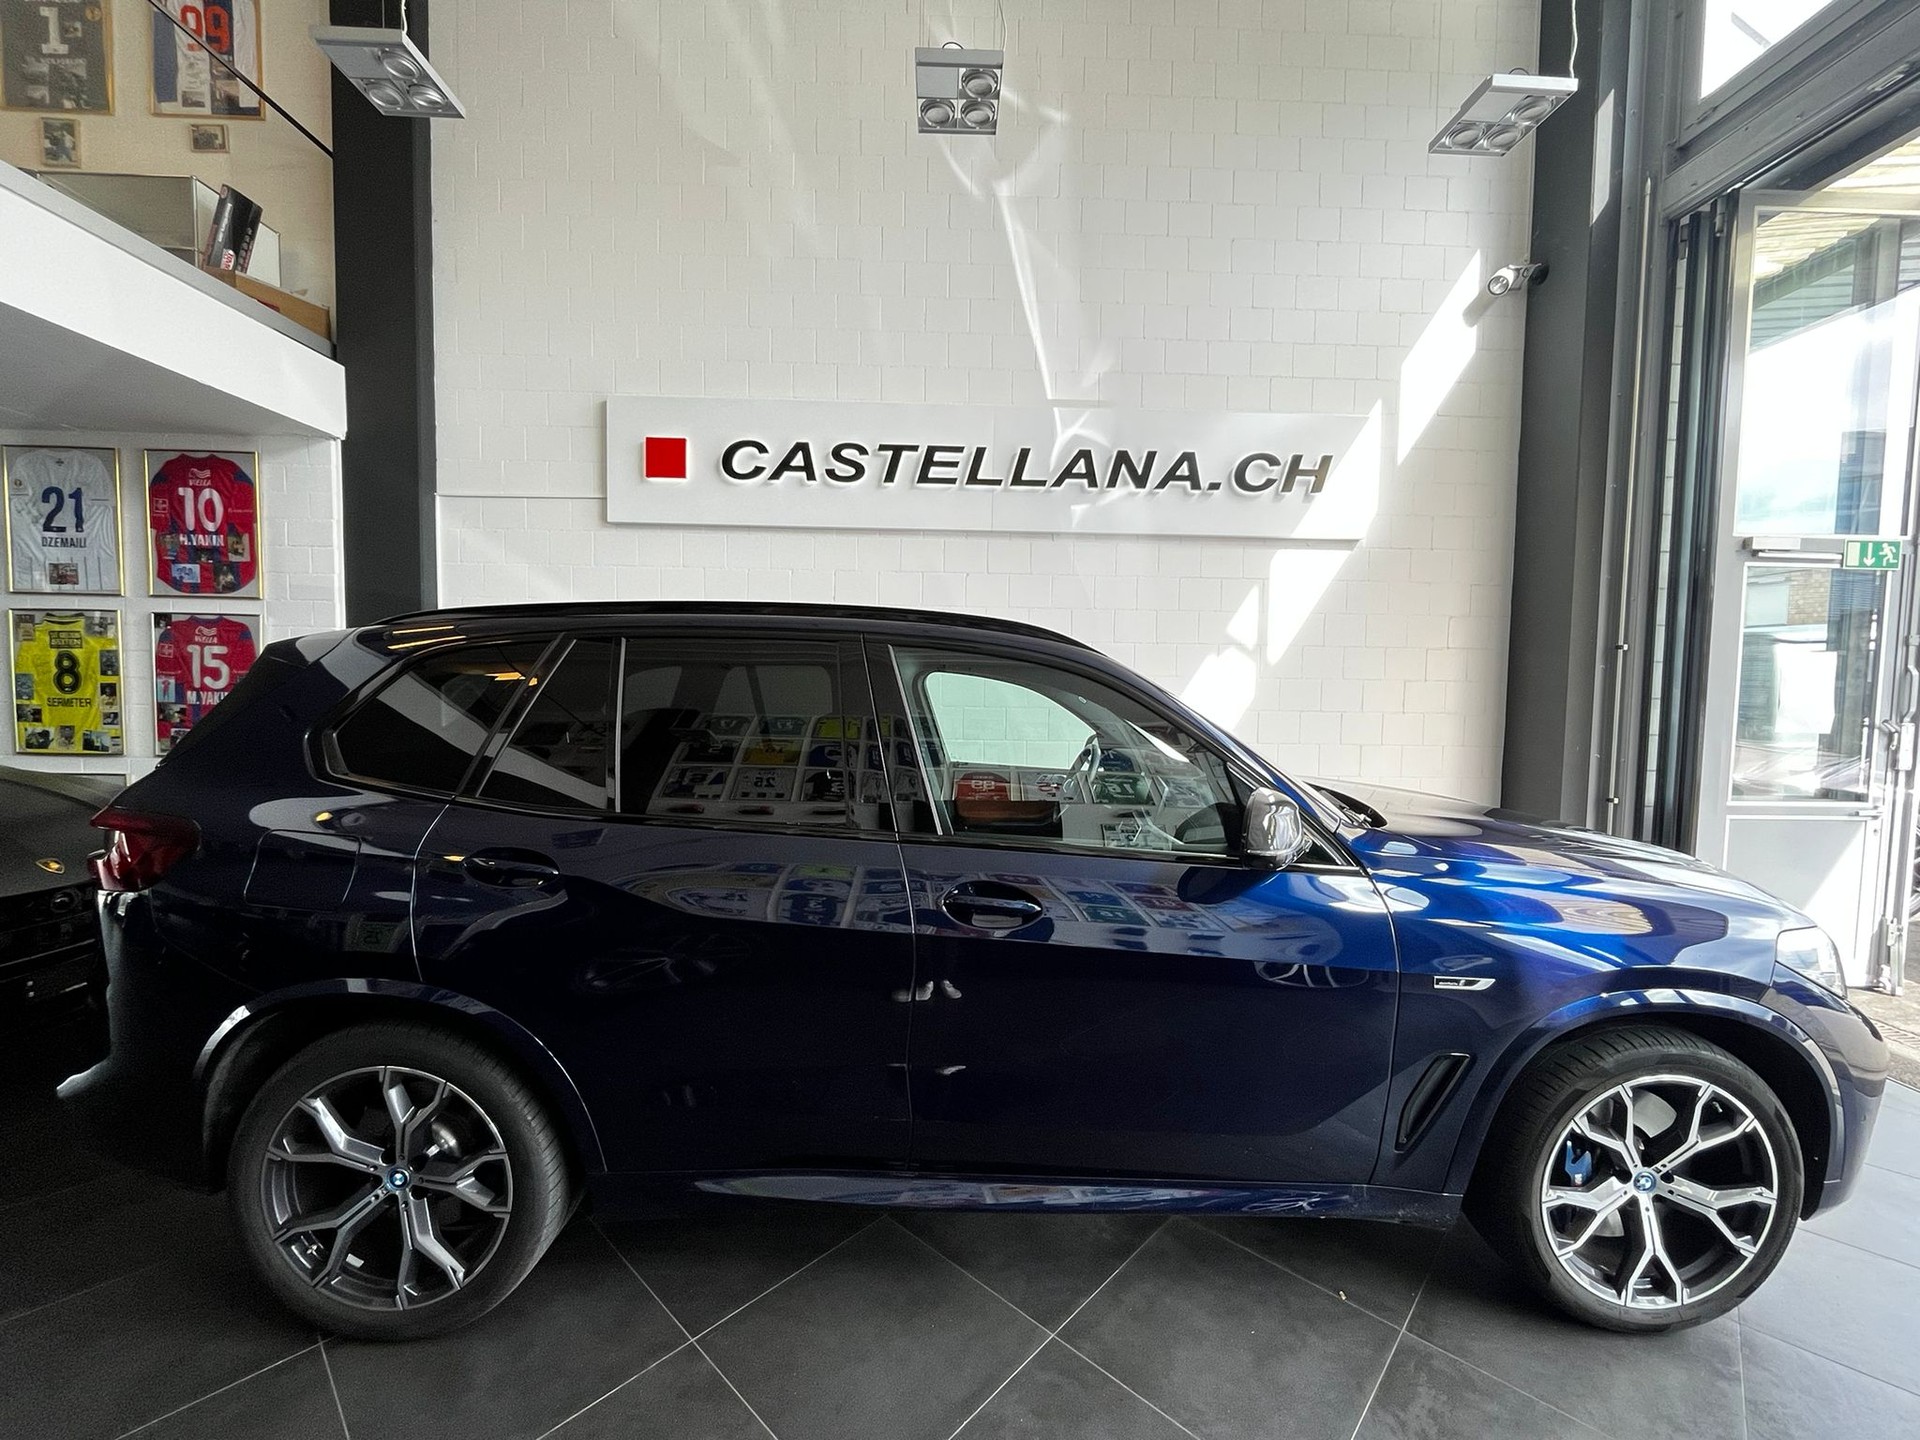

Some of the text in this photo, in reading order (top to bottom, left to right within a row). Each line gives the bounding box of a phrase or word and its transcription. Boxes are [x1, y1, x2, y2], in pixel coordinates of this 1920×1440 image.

[39, 6, 69, 55] 1
[721, 439, 1334, 494] CASTELLANA.CH
[41, 486, 84, 533] 21
[178, 487, 224, 532] 10
[179, 533, 225, 547] H.YAKIN
[53, 650, 82, 694] 8
[187, 644, 231, 690] 15
